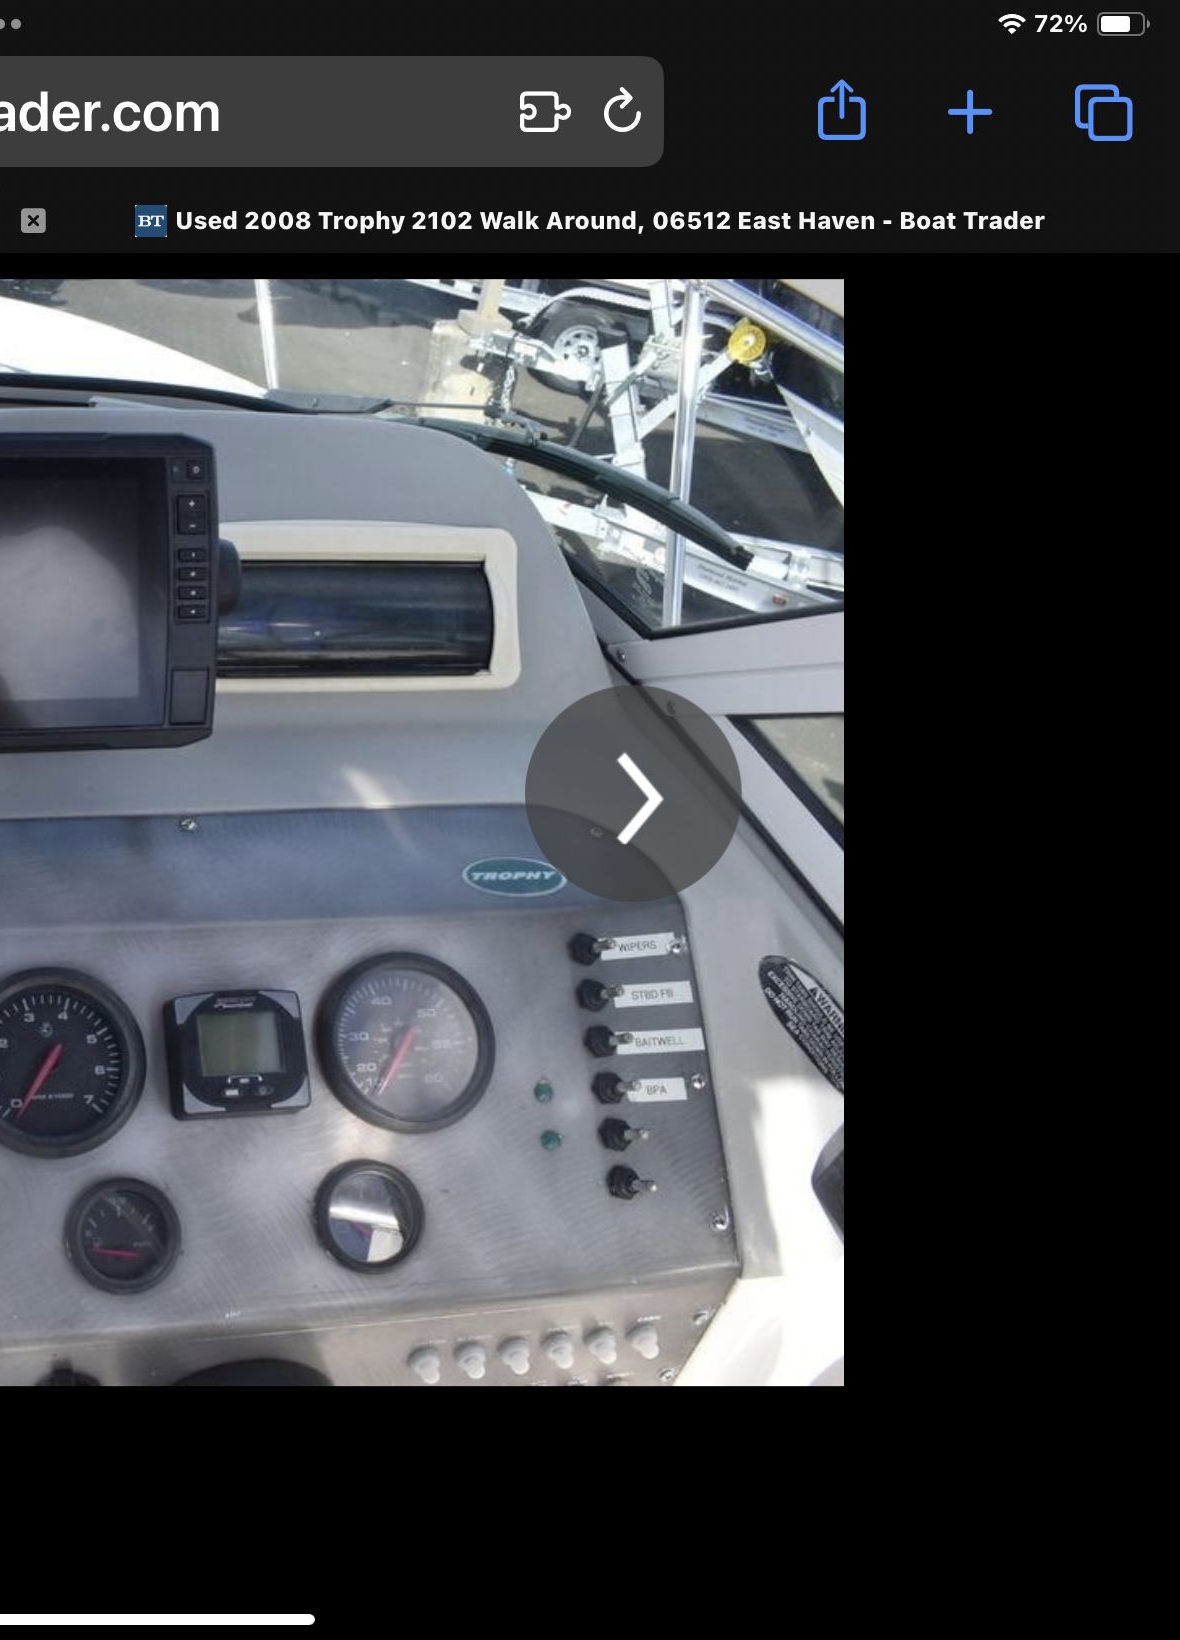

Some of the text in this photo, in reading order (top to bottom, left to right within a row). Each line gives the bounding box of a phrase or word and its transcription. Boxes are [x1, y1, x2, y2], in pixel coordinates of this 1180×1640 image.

[1035, 14, 1087, 33] 72%
[137, 215, 165, 227] BT
[177, 211, 237, 230] Used
[245, 211, 311, 230] 2008
[318, 210, 406, 235] Trophy
[411, 211, 473, 230] 2102
[480, 211, 540, 230] Walk
[546, 211, 643, 234] Around,
[652, 211, 731, 230] 06512
[738, 211, 792, 230] East
[798, 211, 875, 230] Haven
[900, 211, 956, 230] Boat
[963, 211, 1046, 230] Trader
[471, 870, 556, 881] TROPHY
[619, 940, 658, 953] WIPERS
[371, 995, 393, 1006] 40
[631, 989, 659, 1001] STBD
[24, 1012, 35, 1023] 3
[58, 1011, 68, 1021] 4
[86, 1034, 98, 1044] 5
[347, 1031, 369, 1042] 30
[635, 1036, 685, 1048] BAITWELL
[94, 1065, 106, 1076] 6
[356, 1062, 377, 1072] 20
[646, 1084, 668, 1096] BPA
[10, 1098, 23, 1108] 0
[84, 1094, 94, 1105] 7
